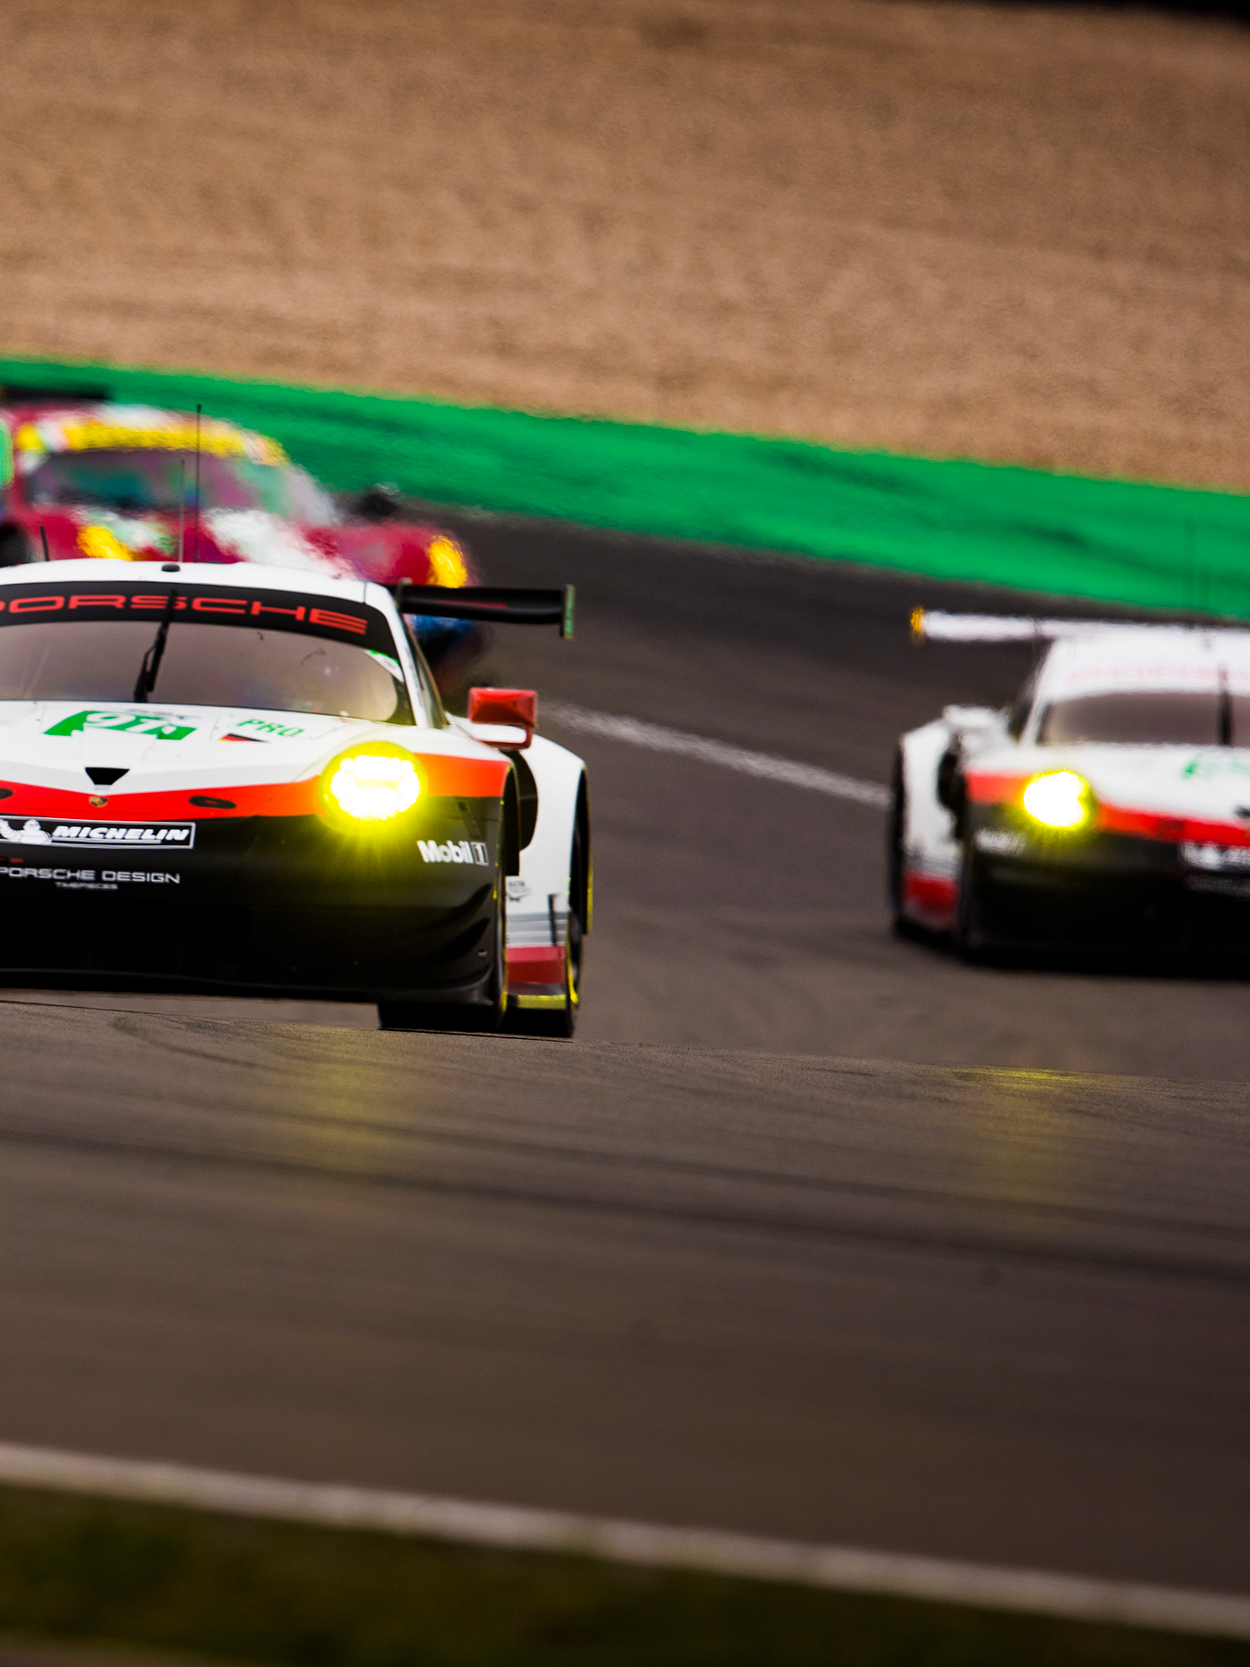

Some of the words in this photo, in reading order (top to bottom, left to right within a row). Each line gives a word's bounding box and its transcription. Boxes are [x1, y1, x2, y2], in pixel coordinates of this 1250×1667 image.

[236, 718, 305, 738] PRO
[52, 825, 190, 841] MICHELIN
[417, 840, 474, 863] Mobil
[101, 870, 181, 884] DESIGN
